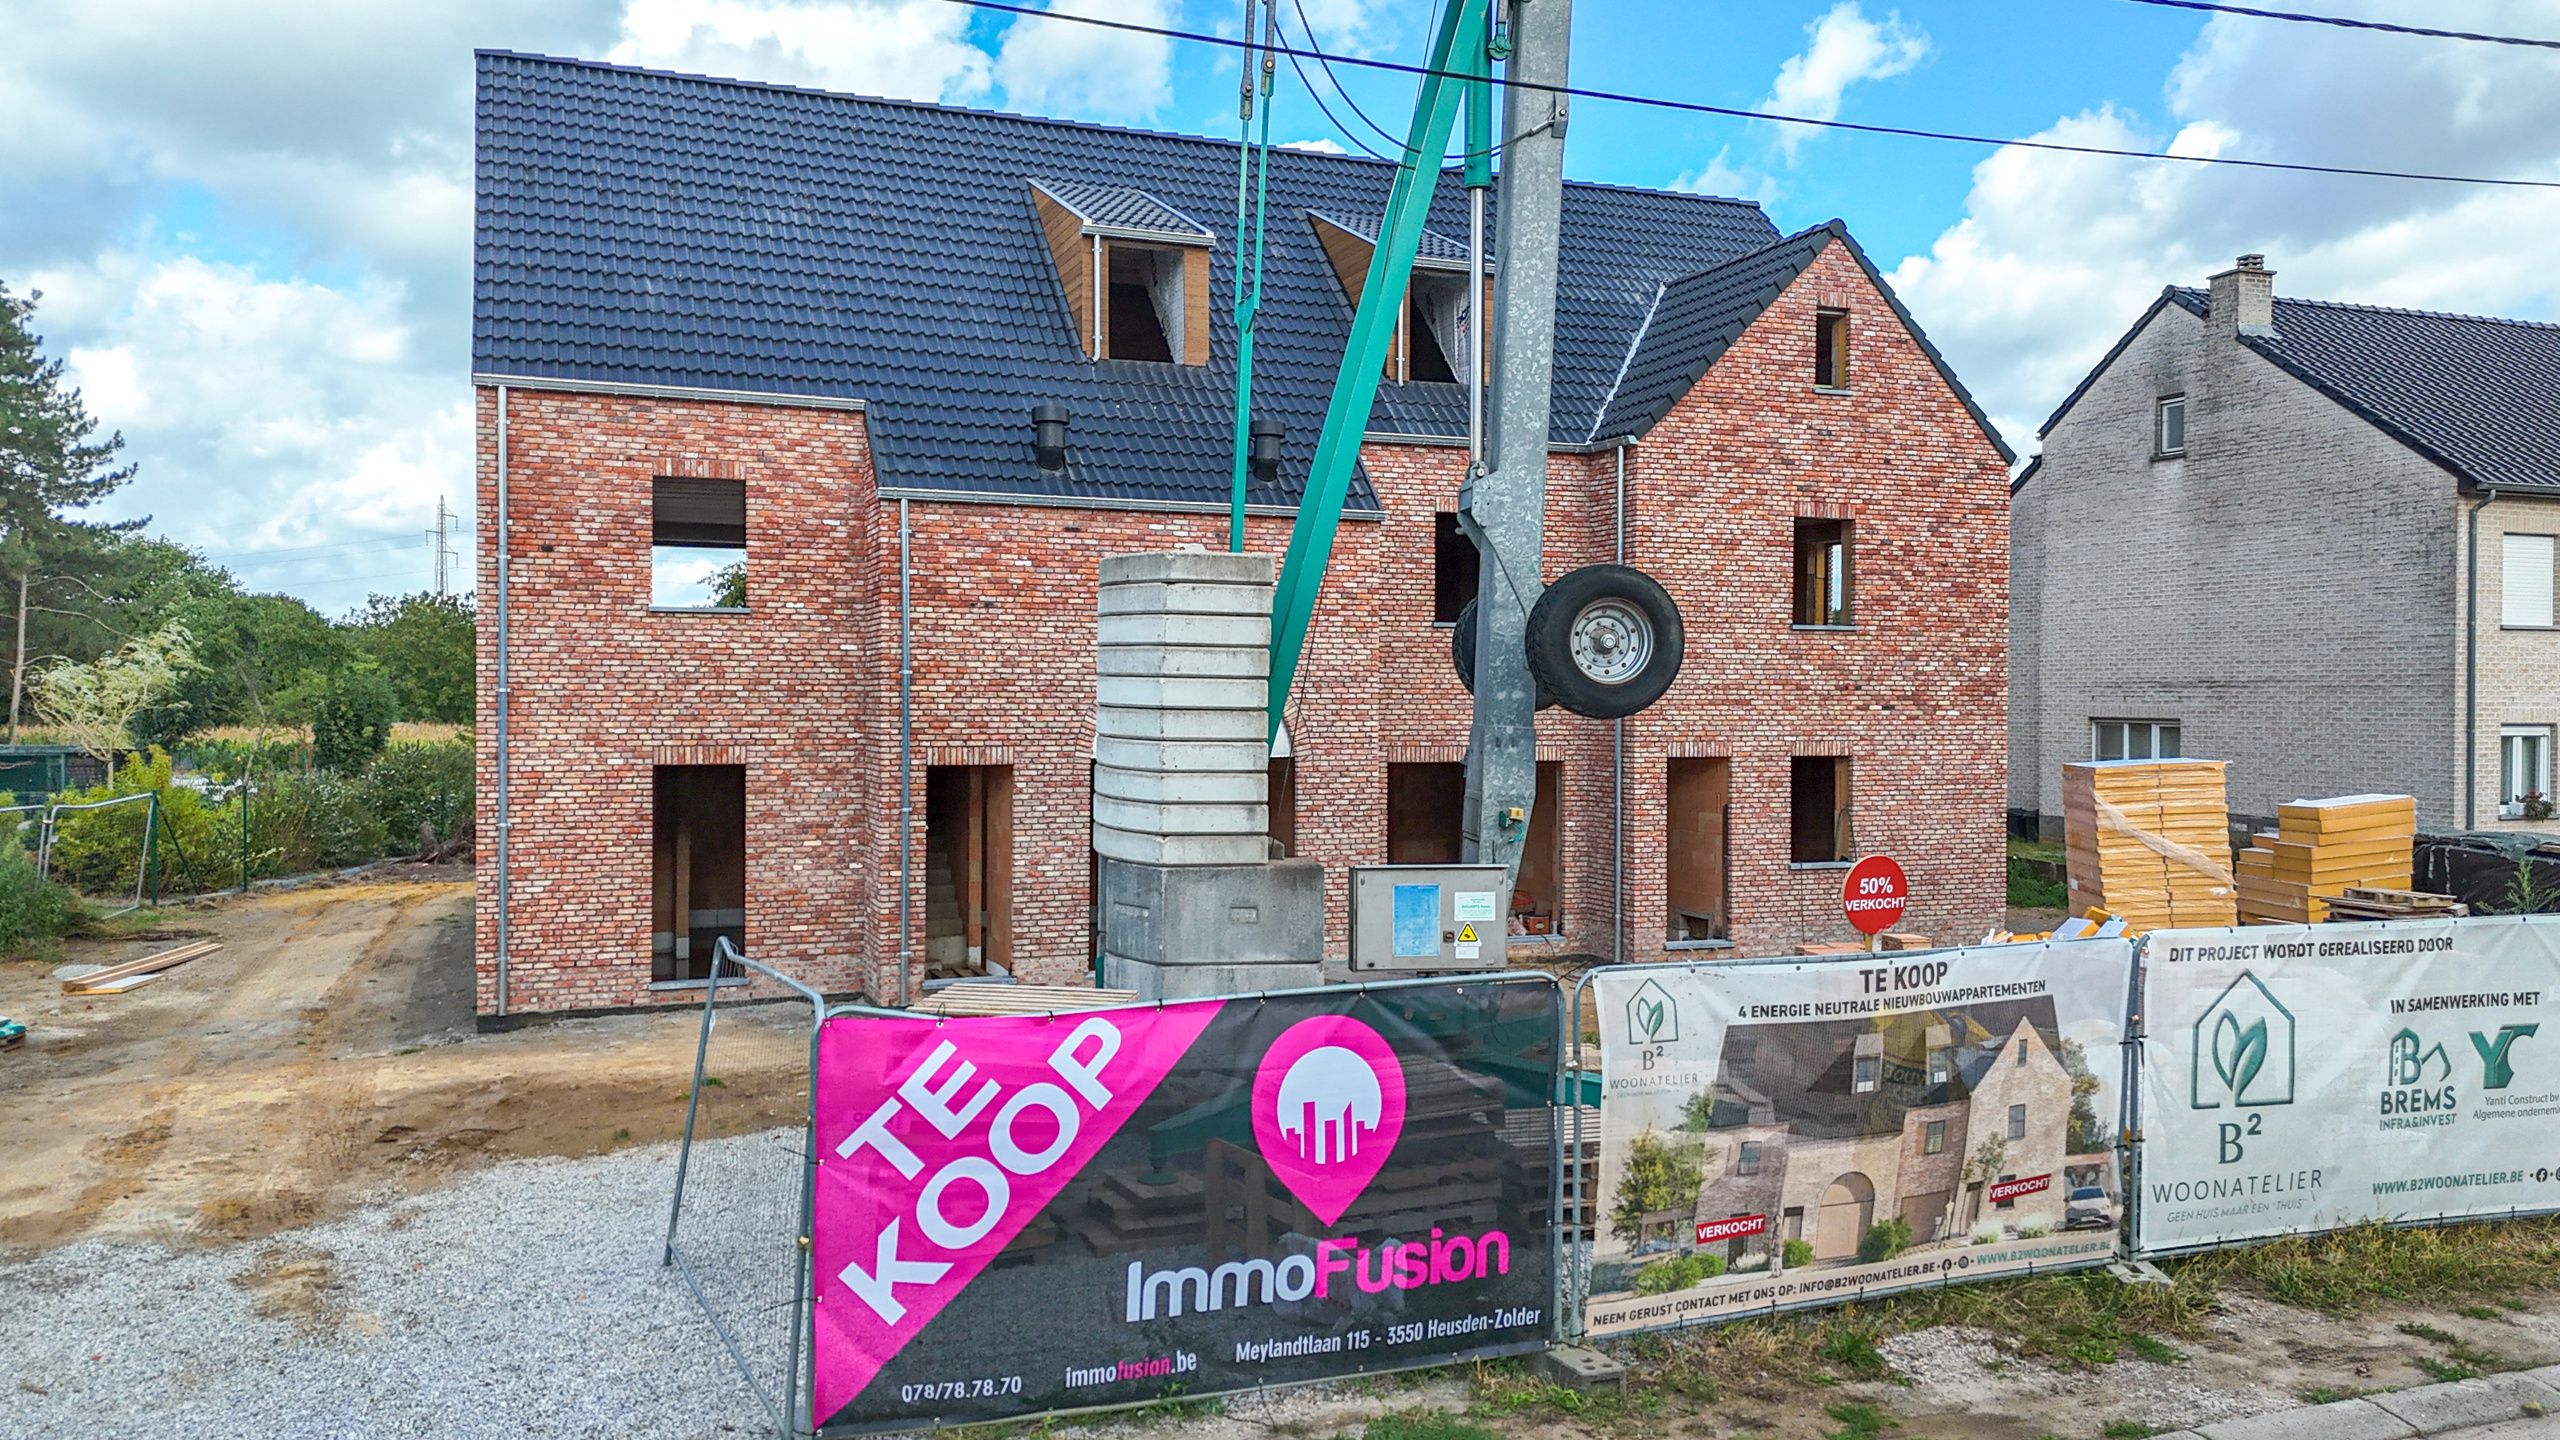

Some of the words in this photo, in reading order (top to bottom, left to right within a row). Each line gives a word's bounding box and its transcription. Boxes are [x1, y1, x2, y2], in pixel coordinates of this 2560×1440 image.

[1860, 876, 1894, 895] 50%
[1845, 896, 1906, 912] VERKOCHT
[2169, 946, 2193, 963] DIT
[2198, 943, 2260, 961] PROJECT
[2263, 941, 2316, 960] WORDT
[2319, 939, 2415, 957] GEREALISEERD
[2418, 936, 2454, 953] DOOR
[1859, 968, 1887, 994] TE
[1894, 961, 1948, 992] KOOP
[1738, 1005, 1747, 1019] 4
[1751, 1003, 1812, 1019] ENERGIE
[1815, 997, 1881, 1016] NEUTRALE
[1882, 979, 2047, 1011] NIEUWBOUWAPPARTEMENTEN
[2390, 999, 2405, 1014] IN
[2408, 992, 2509, 1012] SAMENWERKING
[2513, 991, 2541, 1007] MET
[1609, 1072, 1699, 1090] WOONATELIER
[835, 1039, 1002, 1181] TE
[2380, 1085, 2457, 1115] BREMS
[2485, 1095, 2507, 1106] Yanti
[2508, 1093, 2548, 1105] Construct
[2379, 1113, 2457, 1132] INFRA&INVEST
[2472, 1109, 2516, 1122] Algemene
[837, 1017, 1122, 1327] KOOP
[2372, 1169, 2524, 1195] WWW.B2WOONATELIER.BE
[1990, 1176, 2051, 1200] VERKOCHT
[2152, 1169, 2323, 1204] WOONATELIER
[2167, 1211, 2194, 1223] GEEN
[2196, 1207, 2219, 1220] HUIS
[2220, 1204, 2249, 1217] MAAR
[2251, 1202, 2270, 1214] EEN
[1698, 1217, 1764, 1240] VERKOCHT
[1126, 1227, 1510, 1323] ImmoFusion
[1593, 1311, 1626, 1327] NEEM
[1629, 1303, 1673, 1322] GERUST
[1676, 1294, 1726, 1313] CONTACT
[1728, 1290, 1751, 1304] MET
[1754, 1286, 1775, 1301] ONS
[1778, 1283, 1797, 1297] OP:
[1799, 1261, 1936, 1294] INFO@B2WOONATELIER.BE
[1976, 1239, 2112, 1266] WWW.B2WOONATELIER.BE
[1235, 1335, 1342, 1363] Meylandtlaan
[1346, 1330, 1371, 1351] 115
[1387, 1324, 1424, 1346] 3550
[1428, 1306, 1542, 1340] Heusden-Zolder
[1064, 1349, 1198, 1389] immofusion.be
[901, 1375, 1022, 1403] 078/78.78.70
